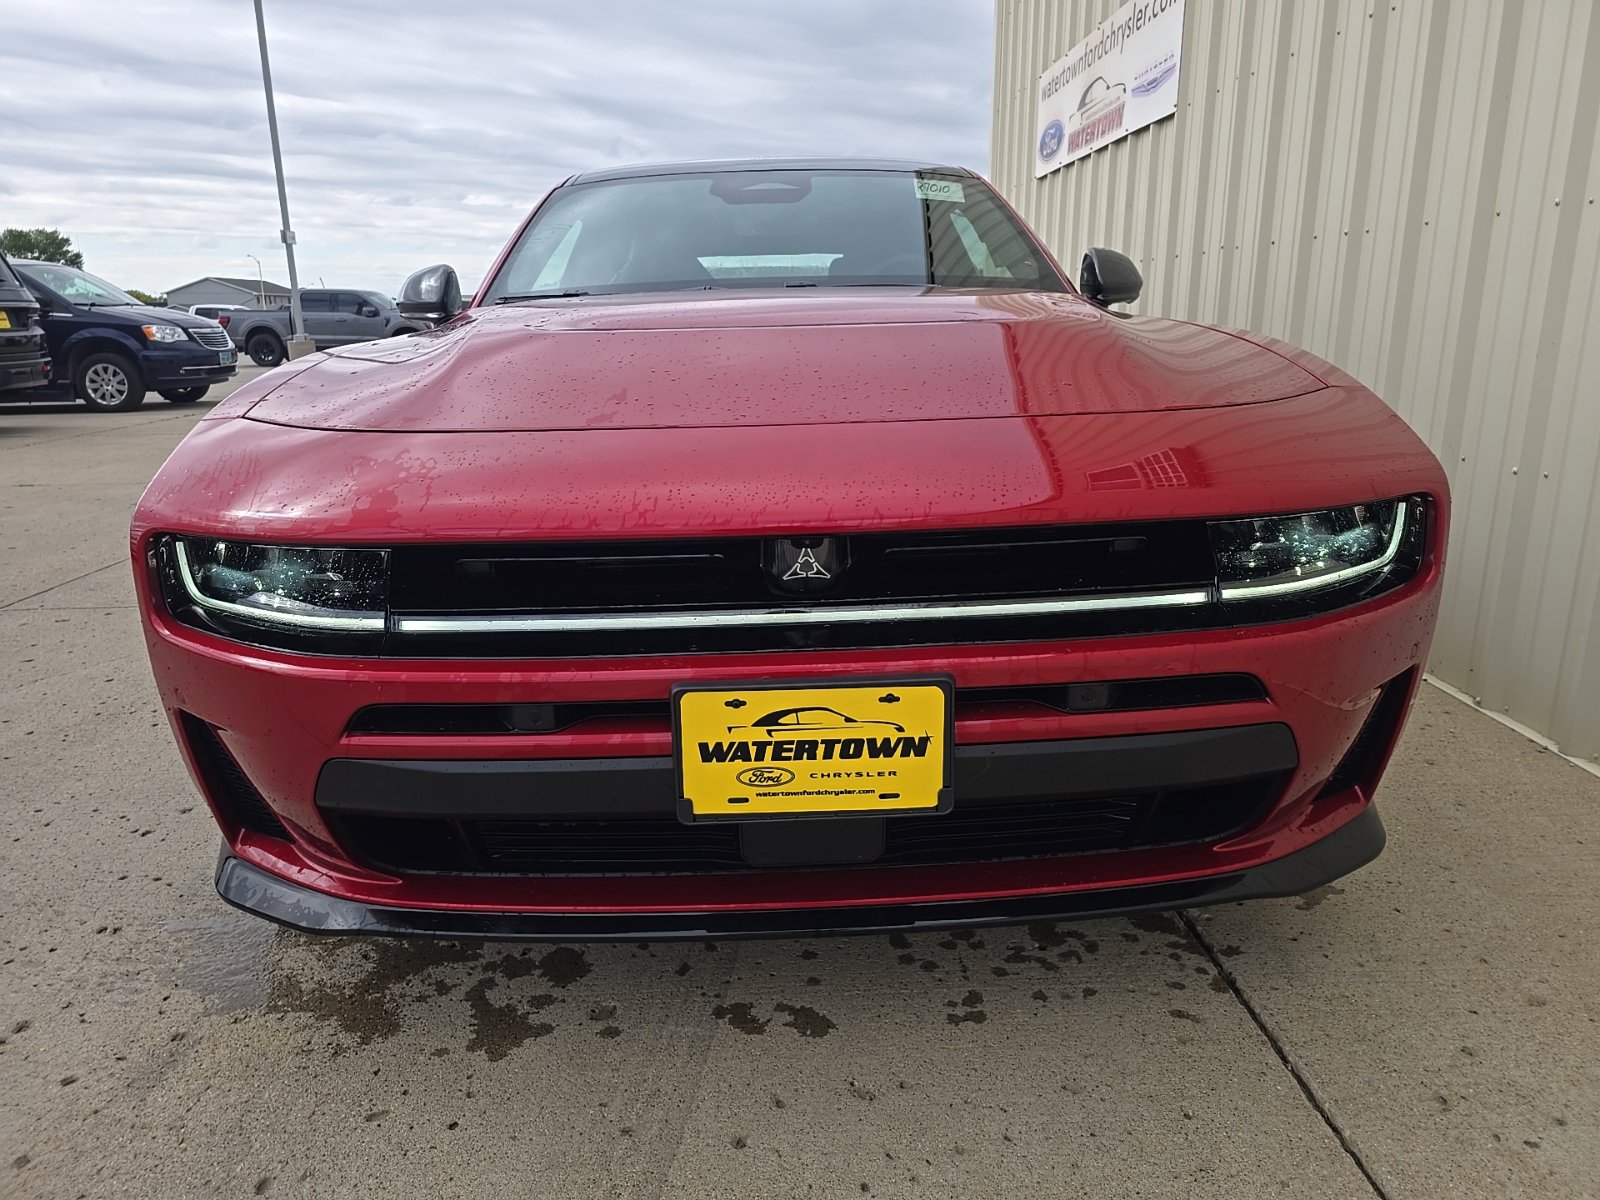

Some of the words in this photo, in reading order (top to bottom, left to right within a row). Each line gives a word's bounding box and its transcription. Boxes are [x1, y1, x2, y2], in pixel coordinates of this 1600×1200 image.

[1041, 0, 1177, 102] watertownfordchrysler.co
[1067, 102, 1126, 156] WATERTOWN
[697, 736, 930, 763] WATERTOWN
[748, 769, 783, 784] Ford
[809, 770, 898, 779] CHRYSLER
[755, 788, 876, 798] watertownfordchrysler.com
